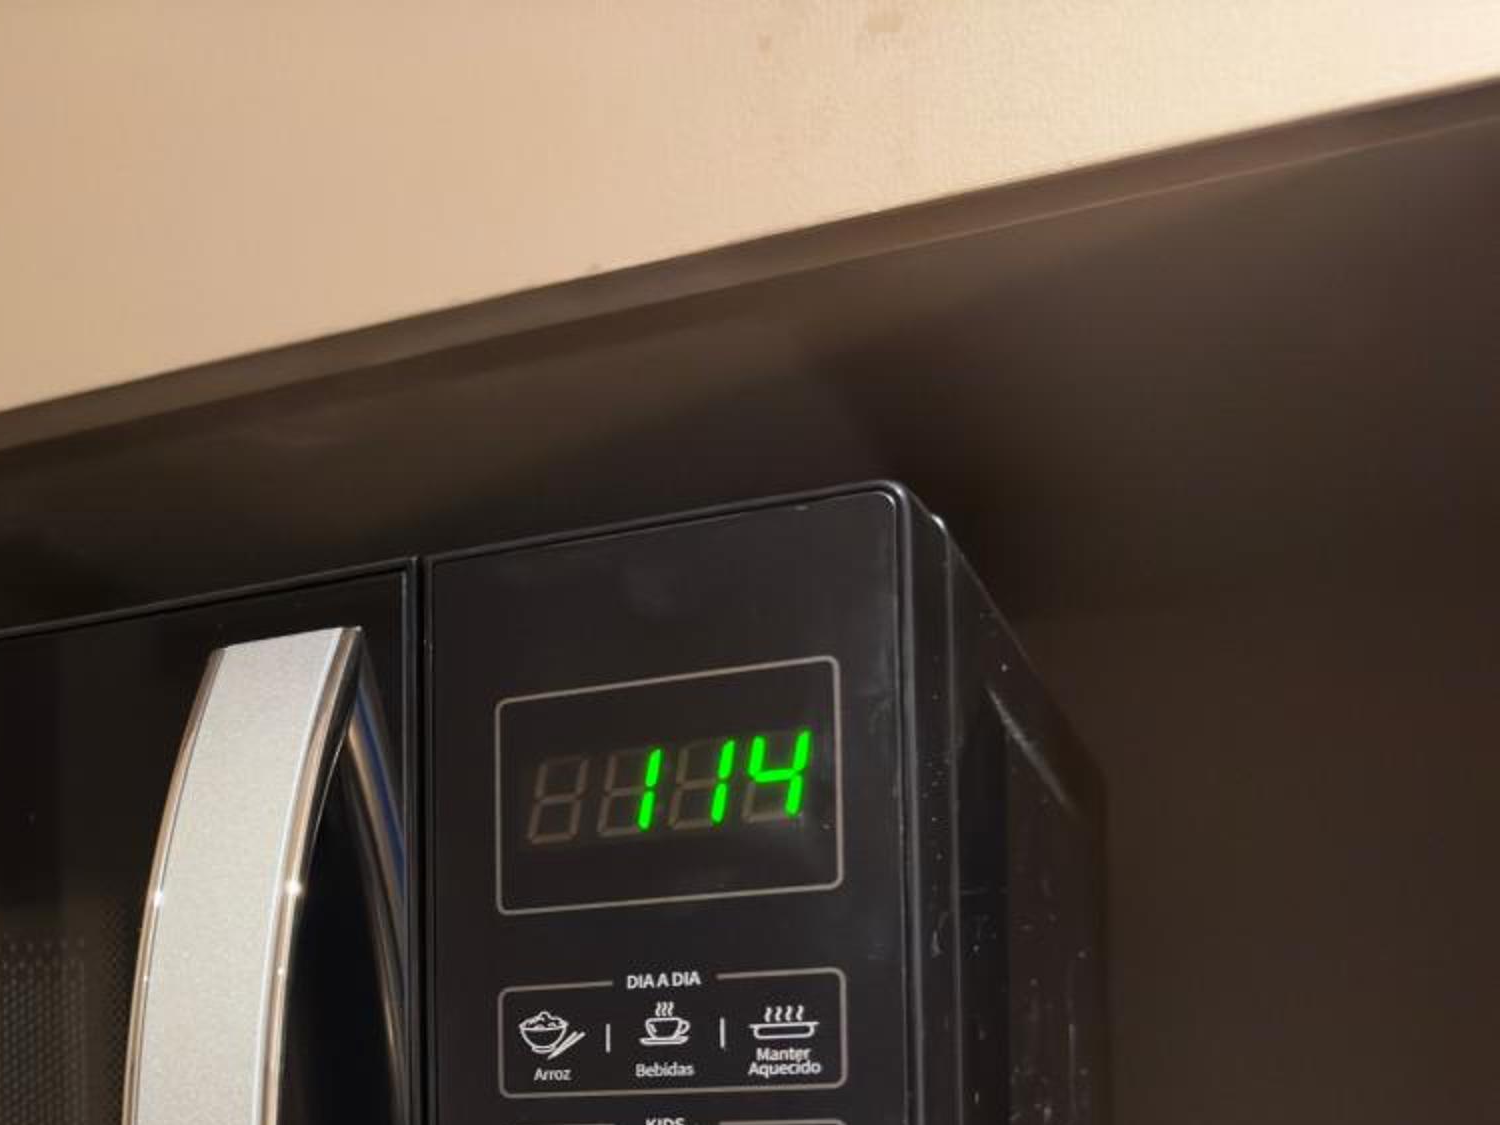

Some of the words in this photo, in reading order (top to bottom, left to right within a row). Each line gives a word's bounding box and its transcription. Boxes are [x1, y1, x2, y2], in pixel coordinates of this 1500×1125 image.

[626, 973, 655, 990] DIA
[656, 972, 669, 988] A
[671, 970, 702, 987] DIA
[756, 1047, 811, 1062] Manter
[533, 1067, 572, 1081] Arroz
[635, 1061, 695, 1078] Bebidas
[748, 1061, 822, 1078] Aquecido
